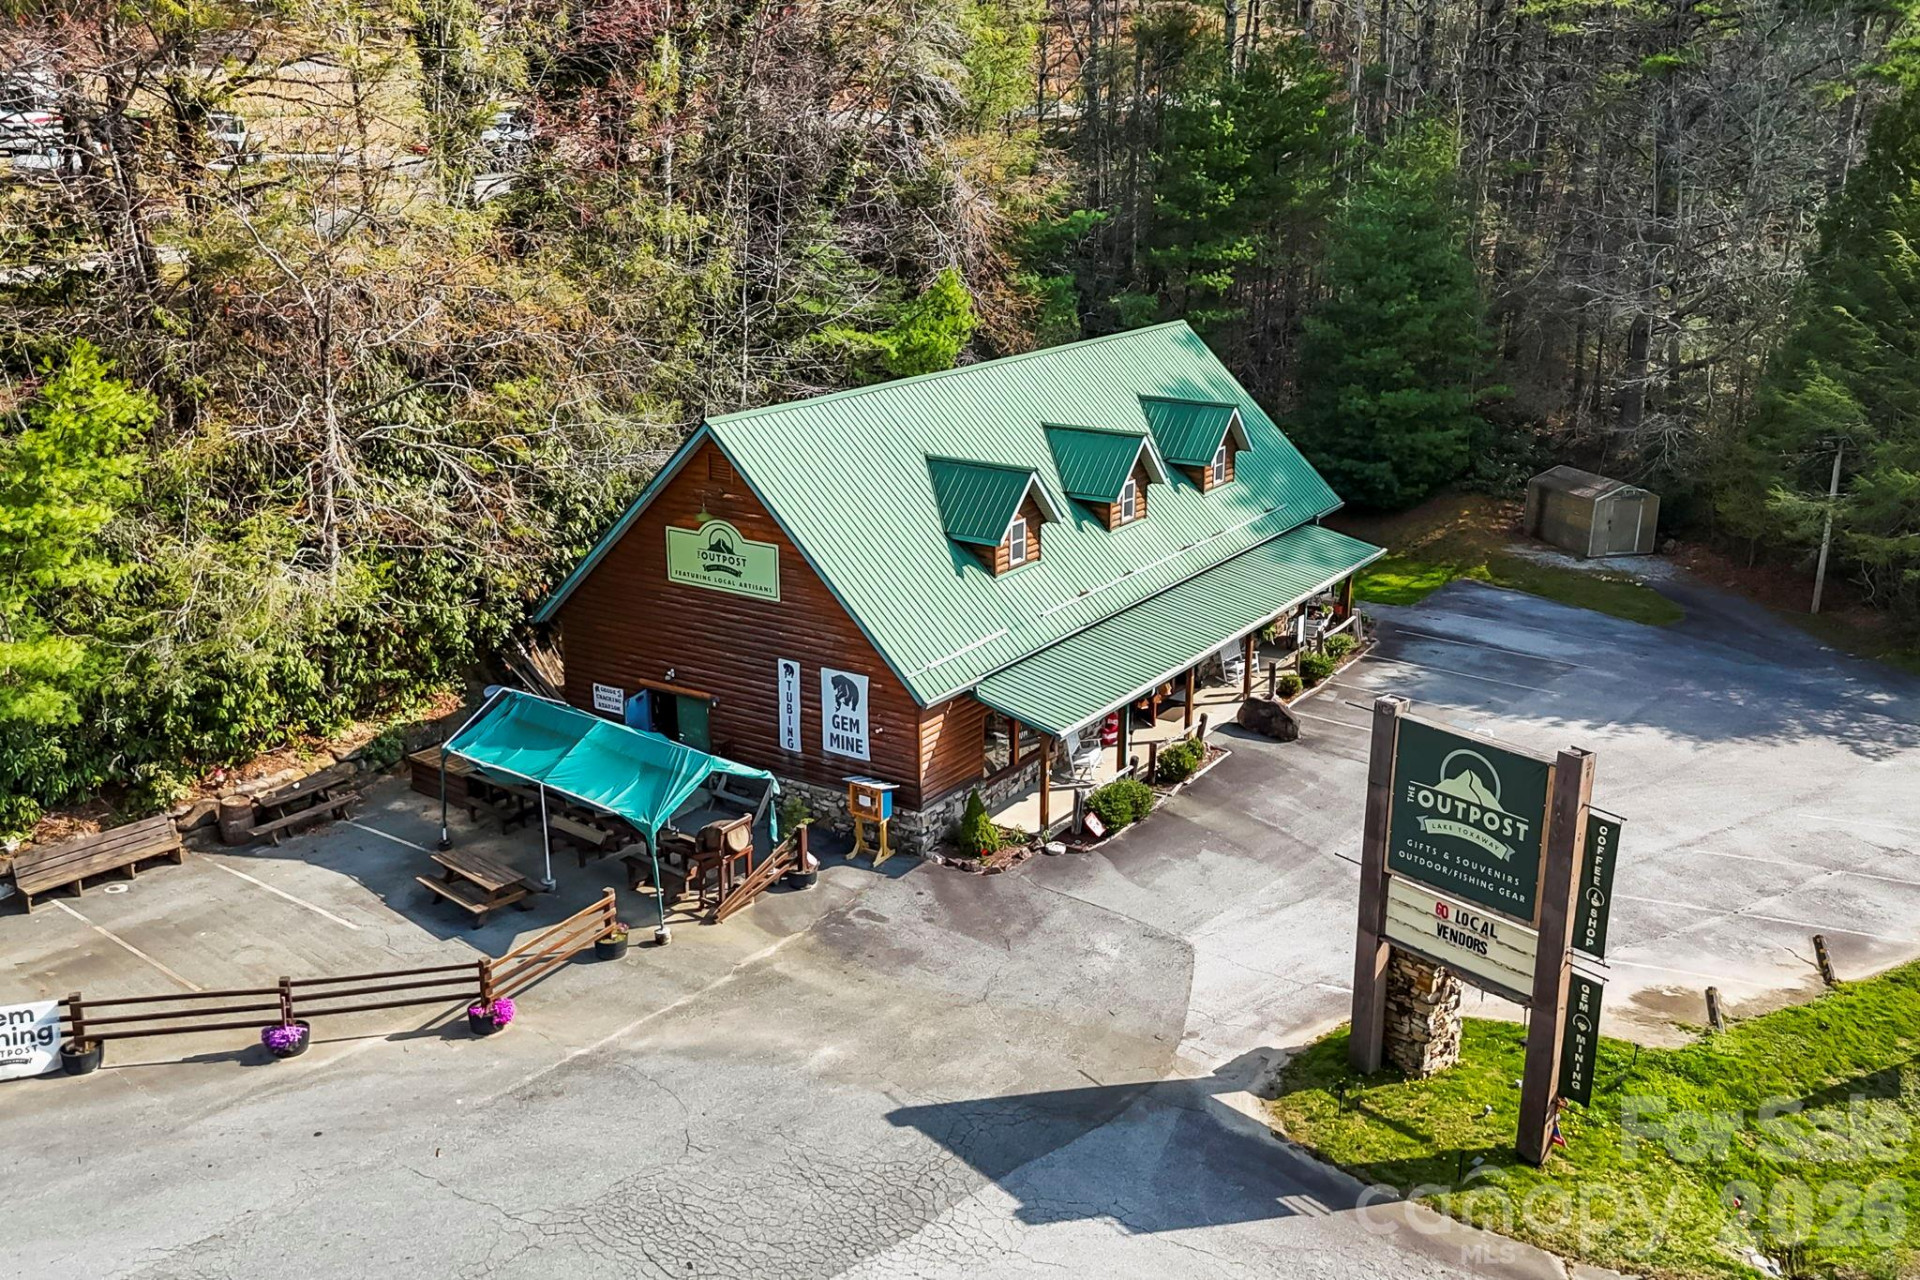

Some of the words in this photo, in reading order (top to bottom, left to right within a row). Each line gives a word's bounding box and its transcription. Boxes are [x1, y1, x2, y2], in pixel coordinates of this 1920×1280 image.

[701, 552, 747, 567] OUTPOST
[675, 570, 711, 582] FEATURING
[714, 578, 736, 586] LOCAL
[739, 582, 773, 593] ARTISANS
[786, 681, 794, 749] TUBING
[832, 714, 860, 734] GEM
[830, 732, 863, 754] MINE
[1407, 785, 1416, 803] THE
[1417, 789, 1529, 841] OUTPOST
[1432, 823, 1453, 831] LAKE
[1458, 828, 1499, 850] TOXAWAY
[1407, 839, 1437, 855] GIFTS
[1444, 851, 1450, 860] &
[1456, 856, 1520, 886] SOUVENIRS
[1593, 826, 1608, 886] COFFEE
[1399, 850, 1494, 891] OUTDOOR/FISHING
[1499, 888, 1526, 903] GEAR
[1437, 922, 1488, 955] VENDORS
[1455, 909, 1497, 939] LOCAL
[1586, 908, 1598, 946] SHOP
[1579, 984, 1590, 1012] GEM
[0, 1009, 34, 1027] em
[0, 1025, 54, 1047] ning
[0, 1044, 38, 1058] TPOST
[1571, 1034, 1586, 1090] MINING
